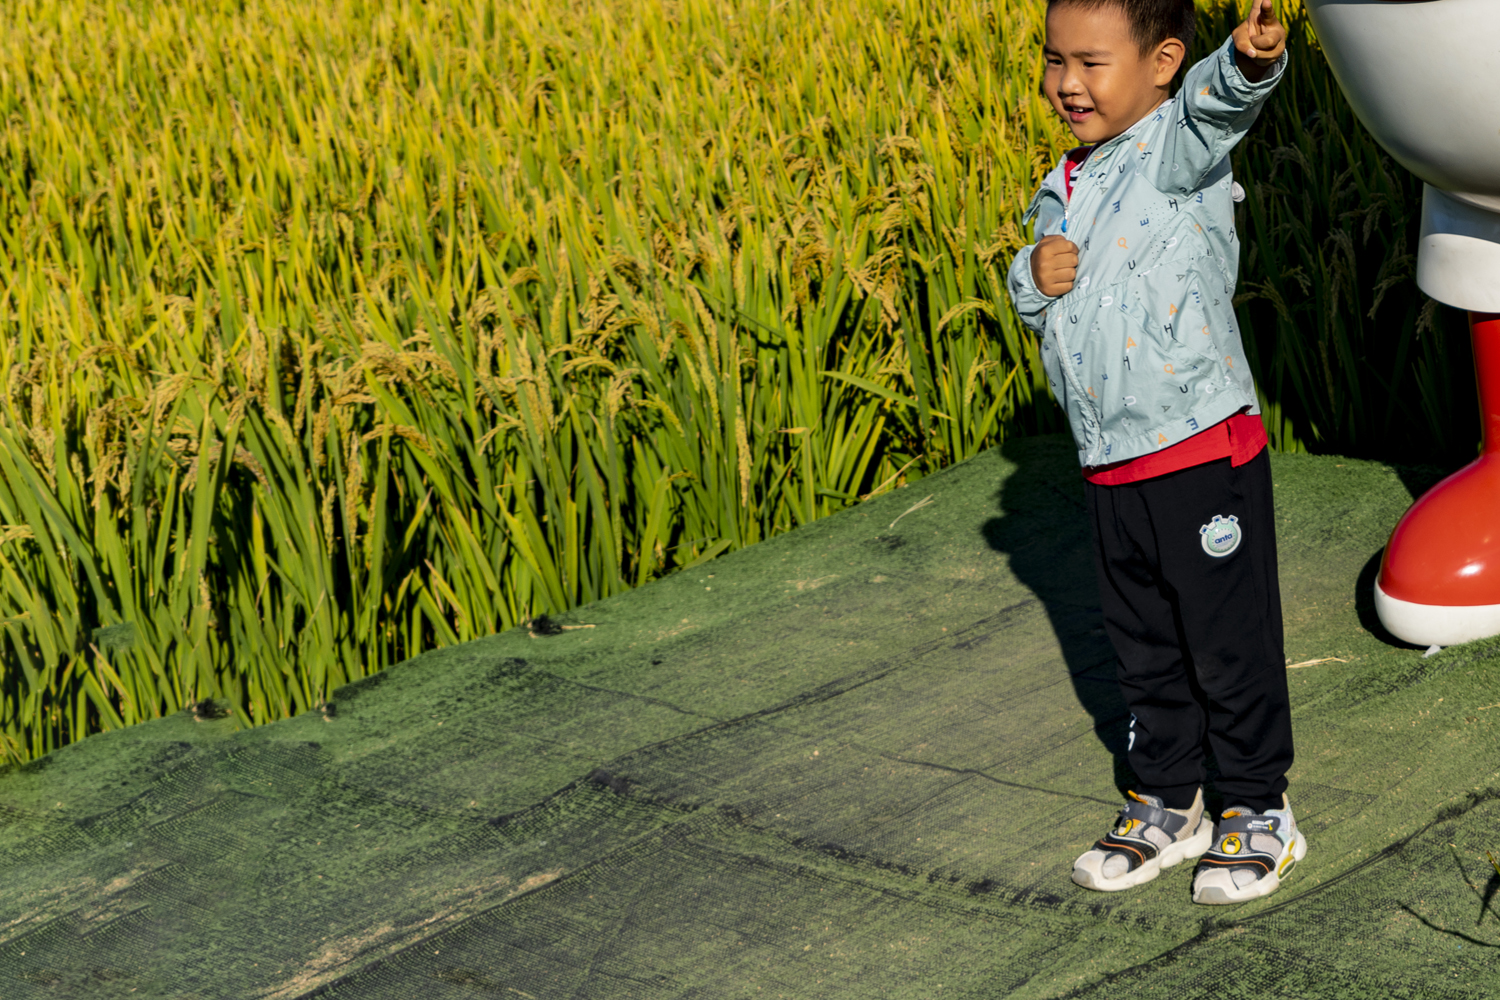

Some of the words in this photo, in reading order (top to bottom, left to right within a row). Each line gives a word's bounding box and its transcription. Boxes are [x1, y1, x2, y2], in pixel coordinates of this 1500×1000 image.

[1118, 237, 1128, 250] Q
[1169, 303, 1178, 316] A
[1126, 336, 1138, 348] A
[1164, 364, 1176, 375] Q
[1179, 384, 1188, 394] U
[1186, 418, 1199, 430] E
[1158, 432, 1168, 445] A
[1214, 534, 1232, 544] anta
